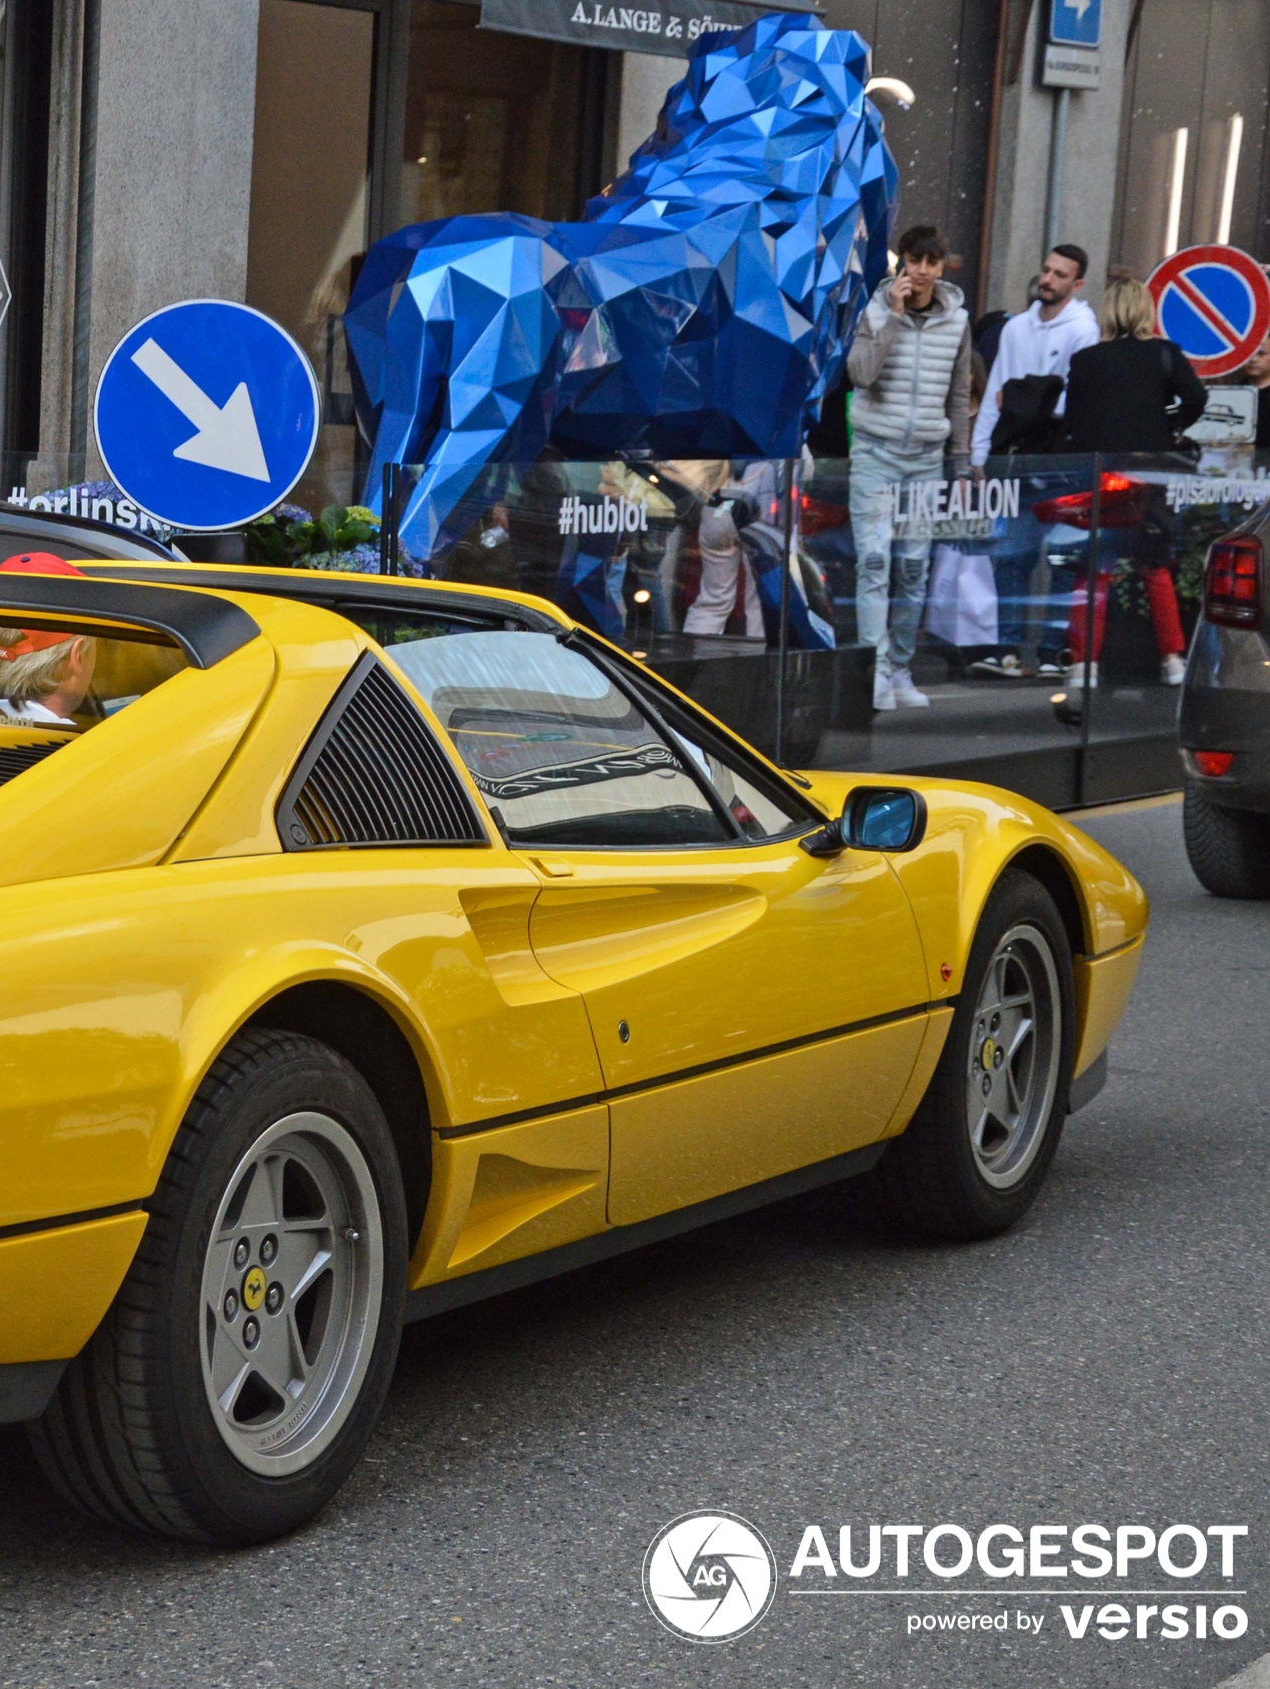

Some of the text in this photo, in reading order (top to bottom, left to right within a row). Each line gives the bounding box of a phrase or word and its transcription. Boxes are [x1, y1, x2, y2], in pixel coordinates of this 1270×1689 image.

[665, 17, 682, 38] &
[8, 486, 170, 531] #orlins
[558, 495, 648, 535] #hublot
